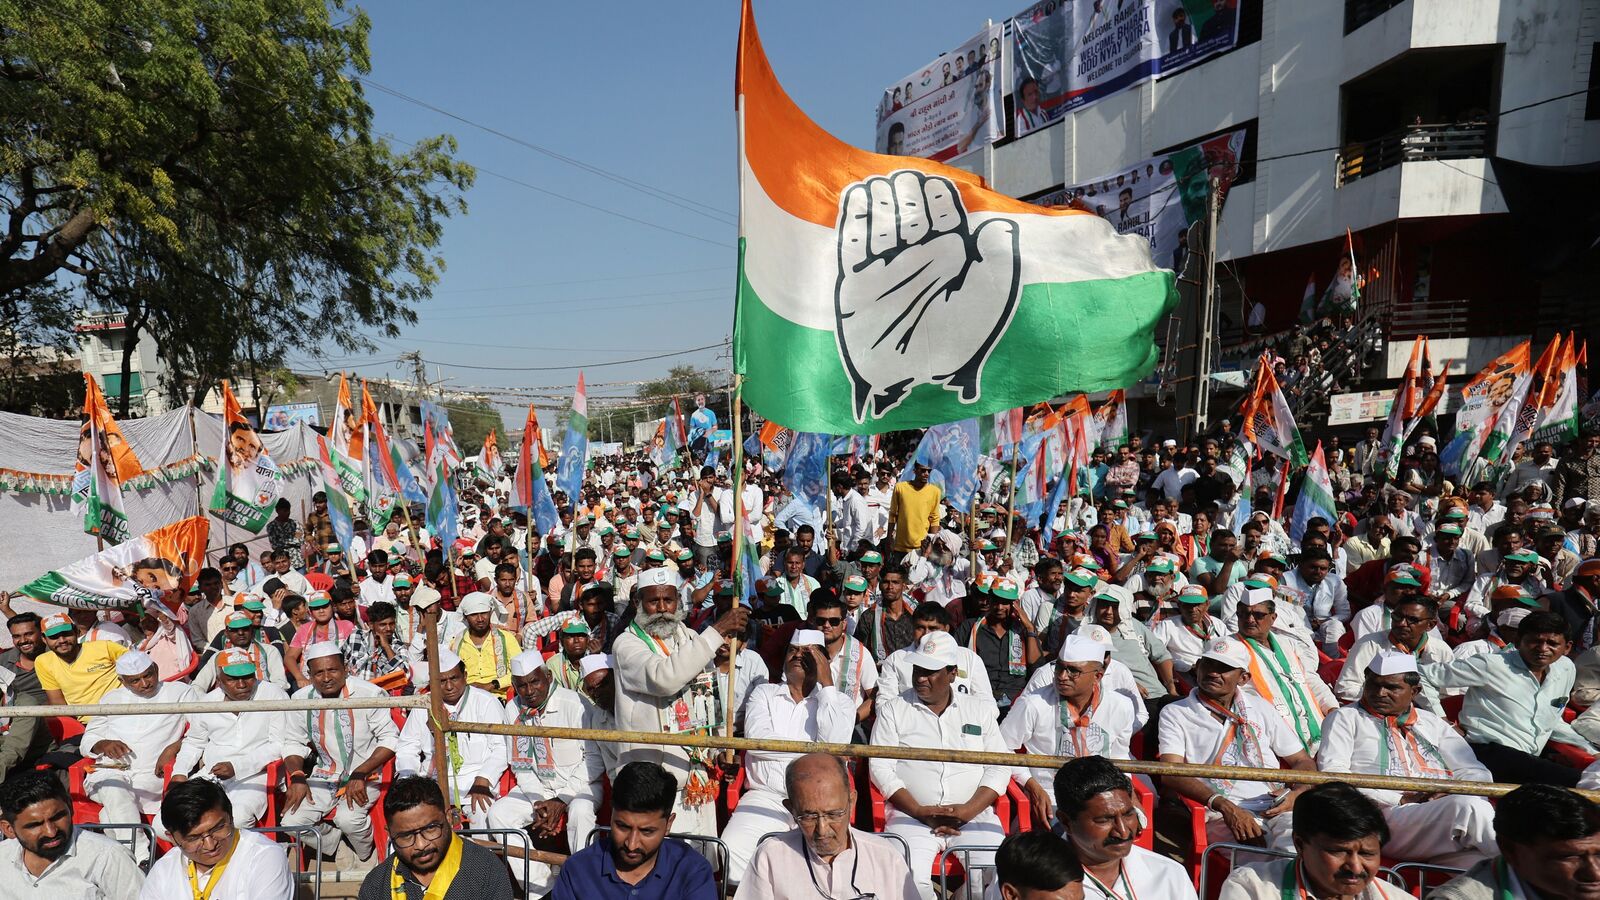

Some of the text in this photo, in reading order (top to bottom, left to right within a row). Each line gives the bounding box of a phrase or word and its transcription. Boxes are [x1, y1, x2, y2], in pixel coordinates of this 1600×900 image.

[1080, 6, 1149, 62] WELCOME BHARAT
[1082, 20, 1112, 46] WELCOME
[1077, 20, 1150, 77] JODO NYAY YATRA
[1086, 61, 1114, 83] WELCOME
[1115, 57, 1123, 68] TO
[231, 499, 263, 521] YOUTH
